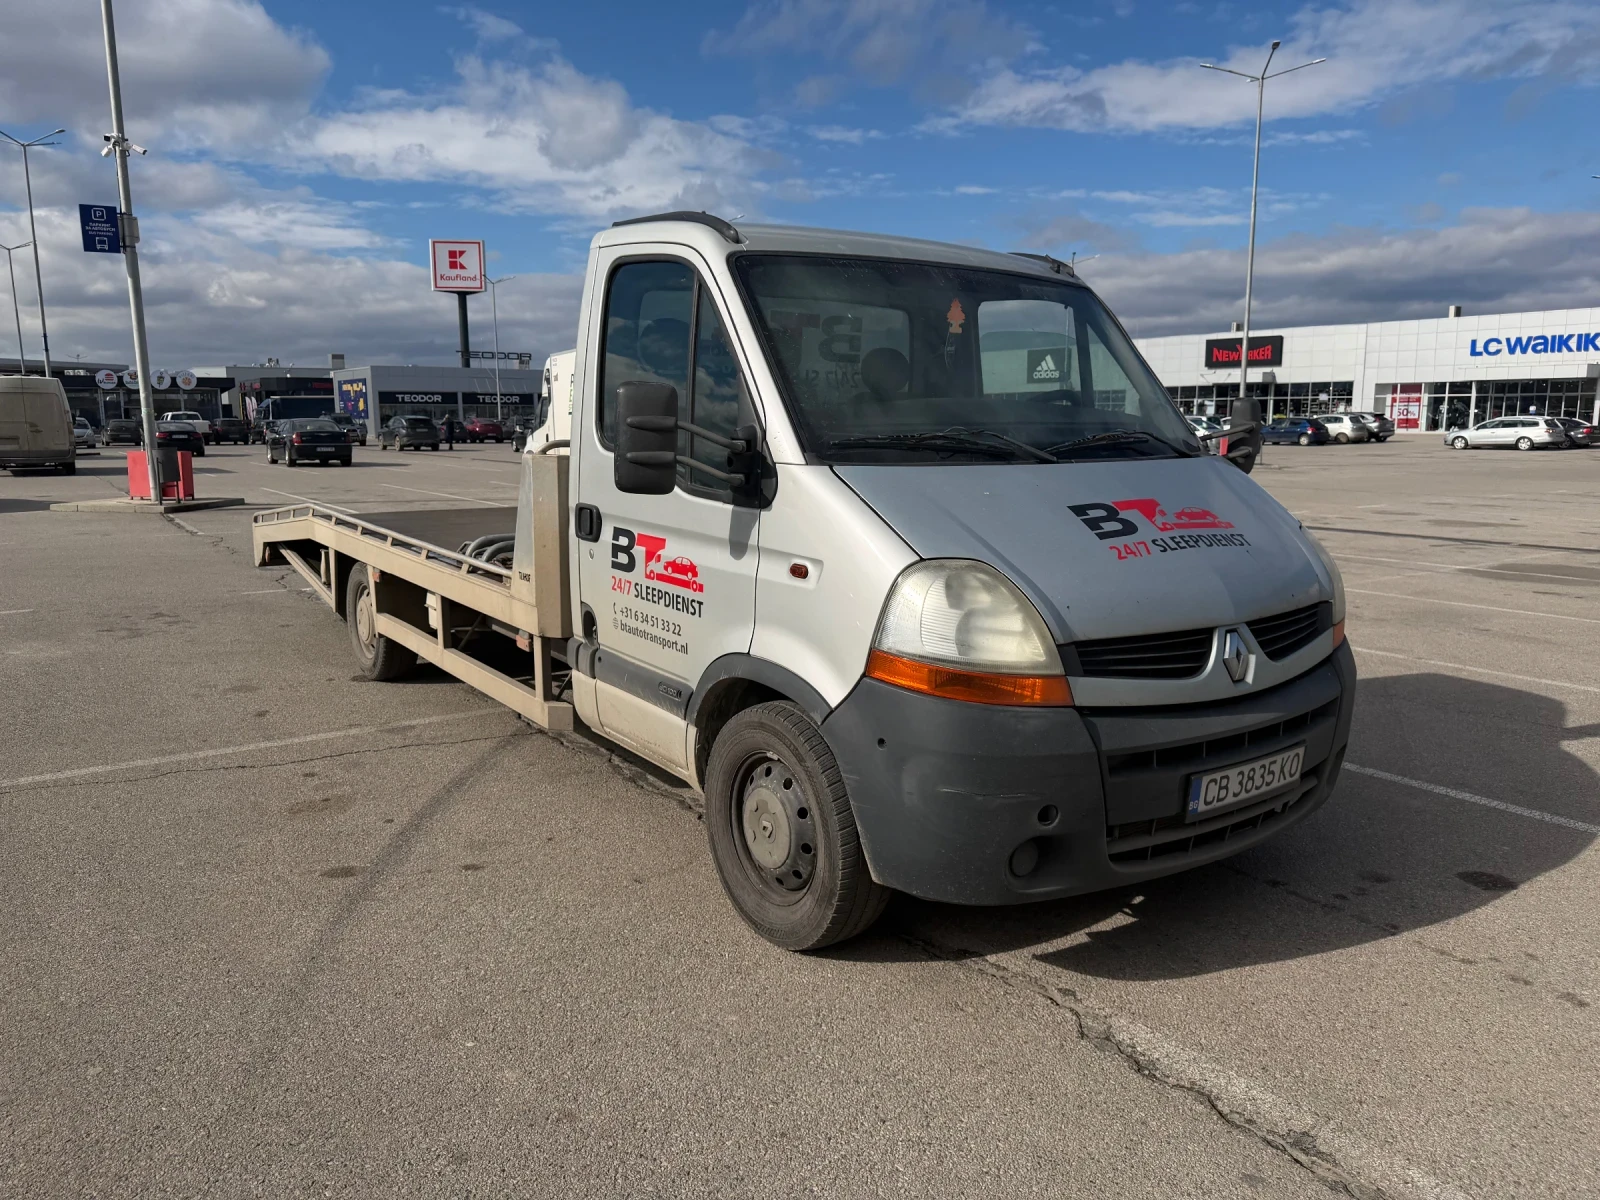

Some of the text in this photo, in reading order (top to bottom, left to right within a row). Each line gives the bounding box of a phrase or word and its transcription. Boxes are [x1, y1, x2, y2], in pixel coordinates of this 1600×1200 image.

[440, 273, 477, 282] Kaufland
[1470, 337, 1503, 357] LC
[456, 350, 532, 361] TEODOR
[1033, 369, 1060, 379] adidas
[395, 394, 442, 403] TEODOR
[477, 395, 520, 403] TEODOR
[1109, 533, 1251, 560] 24/7 SLEEPDIENST
[611, 575, 703, 618] 24/7 SLEEPDIENST
[620, 606, 682, 636] +31 6 34 51 33 22
[620, 620, 688, 655] btautotransport.nl
[1203, 752, 1300, 806] CB 3835 KO
[1189, 800, 1199, 810] BG
